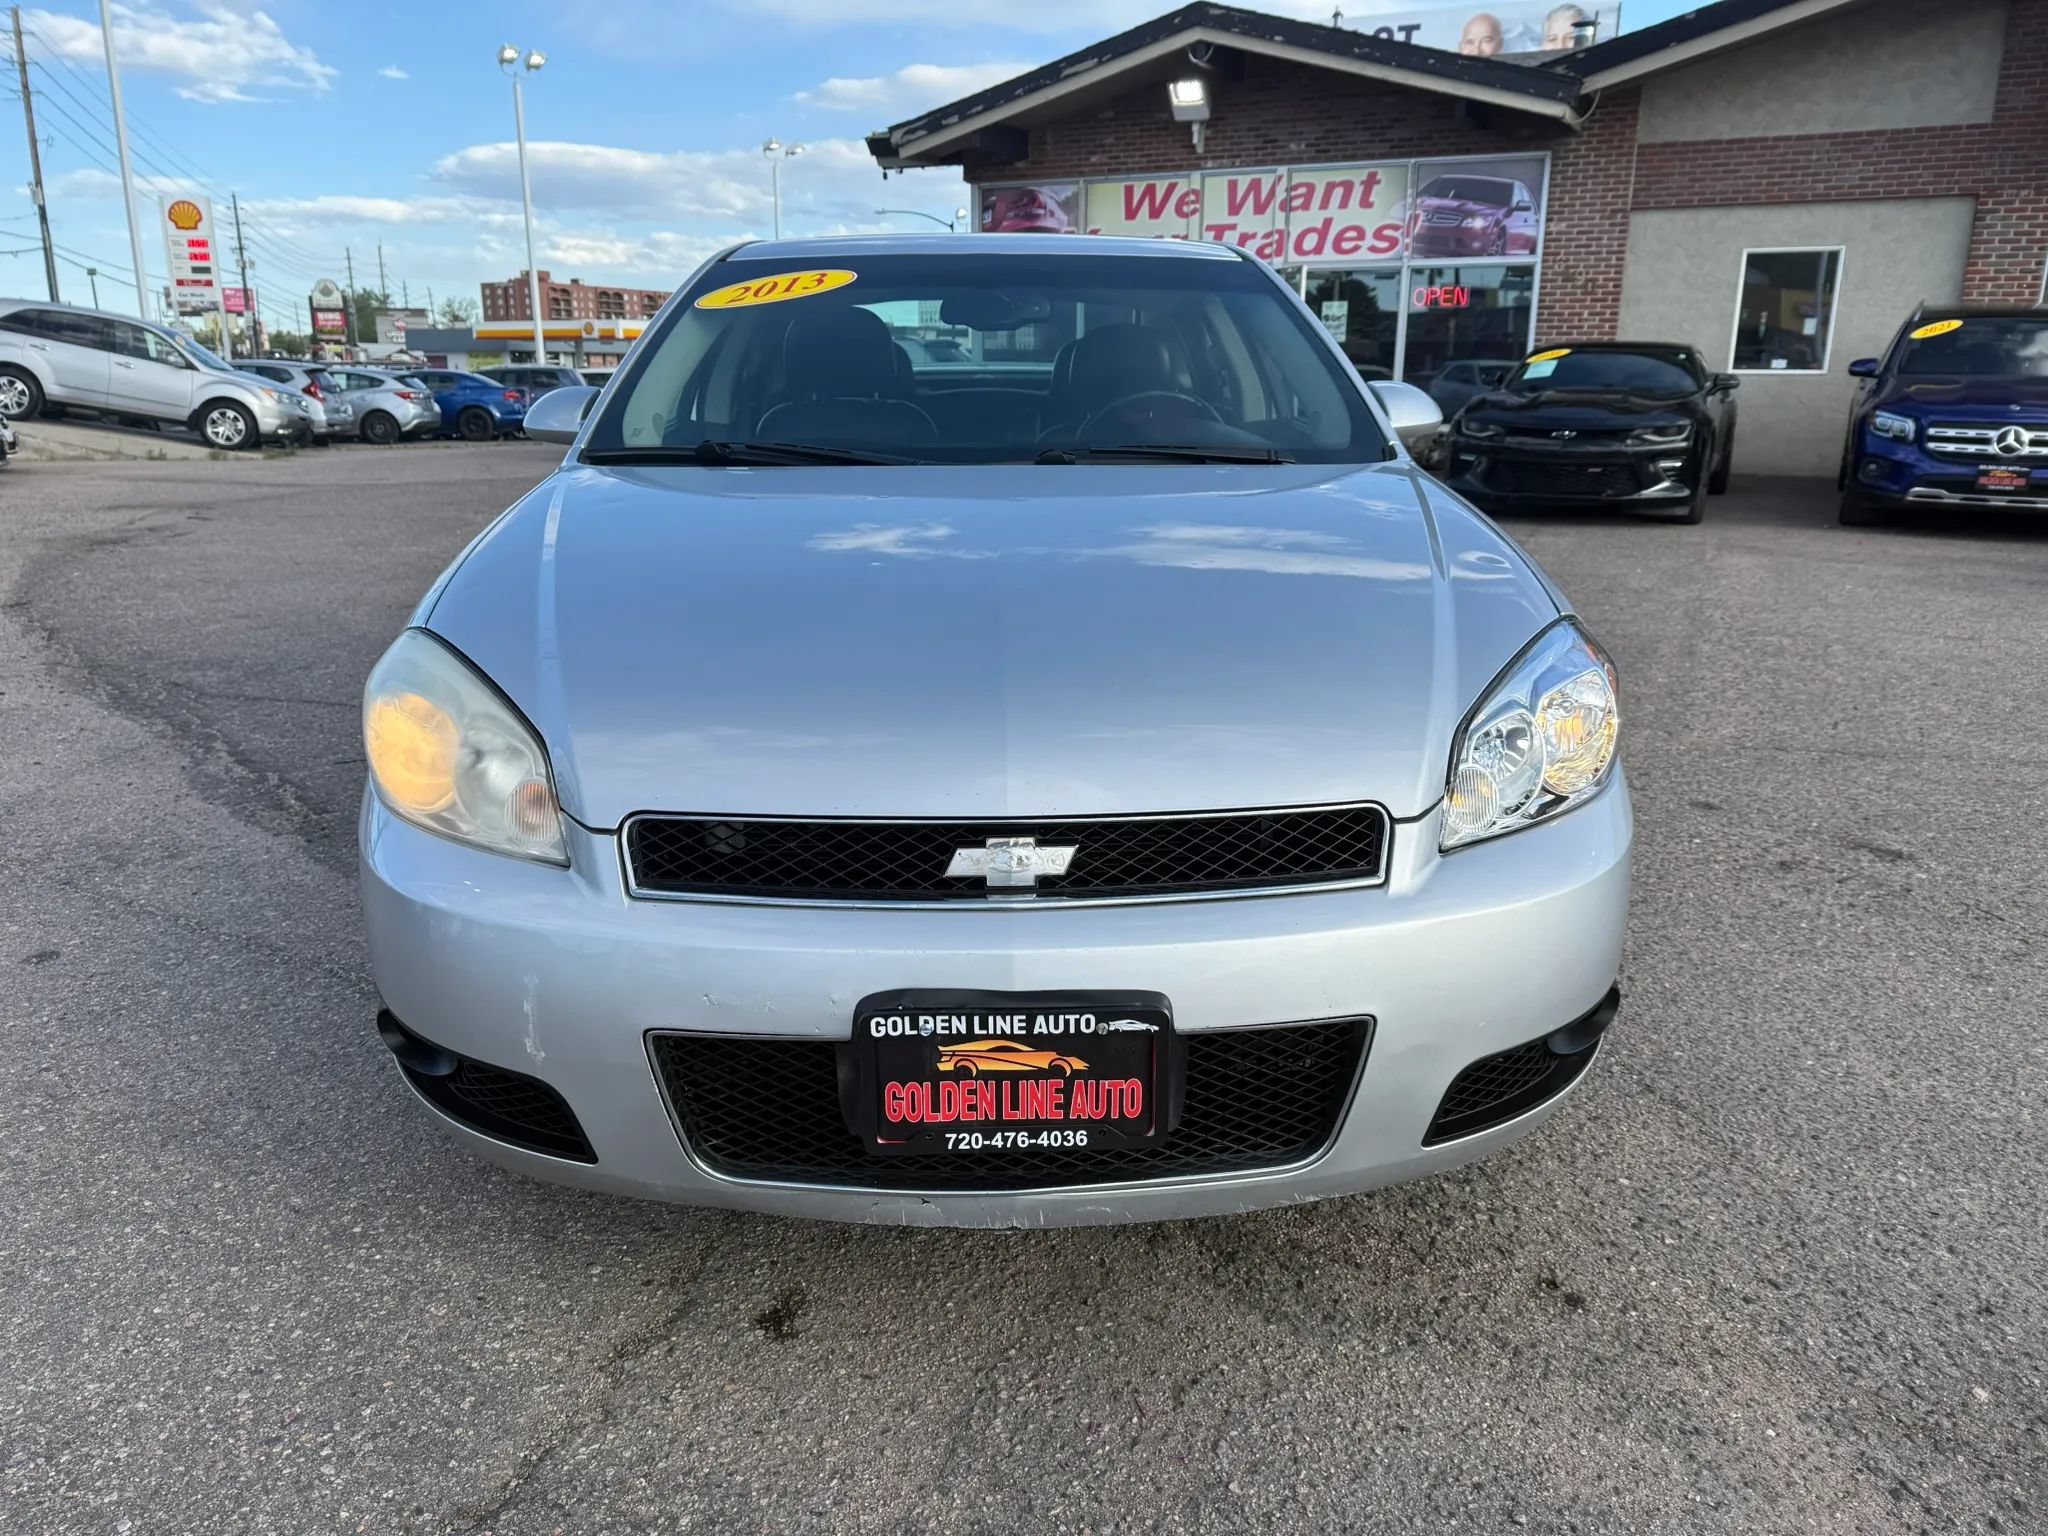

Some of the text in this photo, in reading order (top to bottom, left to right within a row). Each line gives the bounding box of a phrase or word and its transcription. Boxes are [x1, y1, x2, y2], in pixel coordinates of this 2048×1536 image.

[1123, 170, 1383, 222] We Want
[724, 272, 829, 304] 2013
[1412, 286, 1471, 308] OPEN
[870, 1014, 1096, 1037] GOLDEN LINE AUTO
[884, 1078, 1143, 1123] GOLDEN LINE AUTO
[945, 1130, 1088, 1150] 720-476-4036
